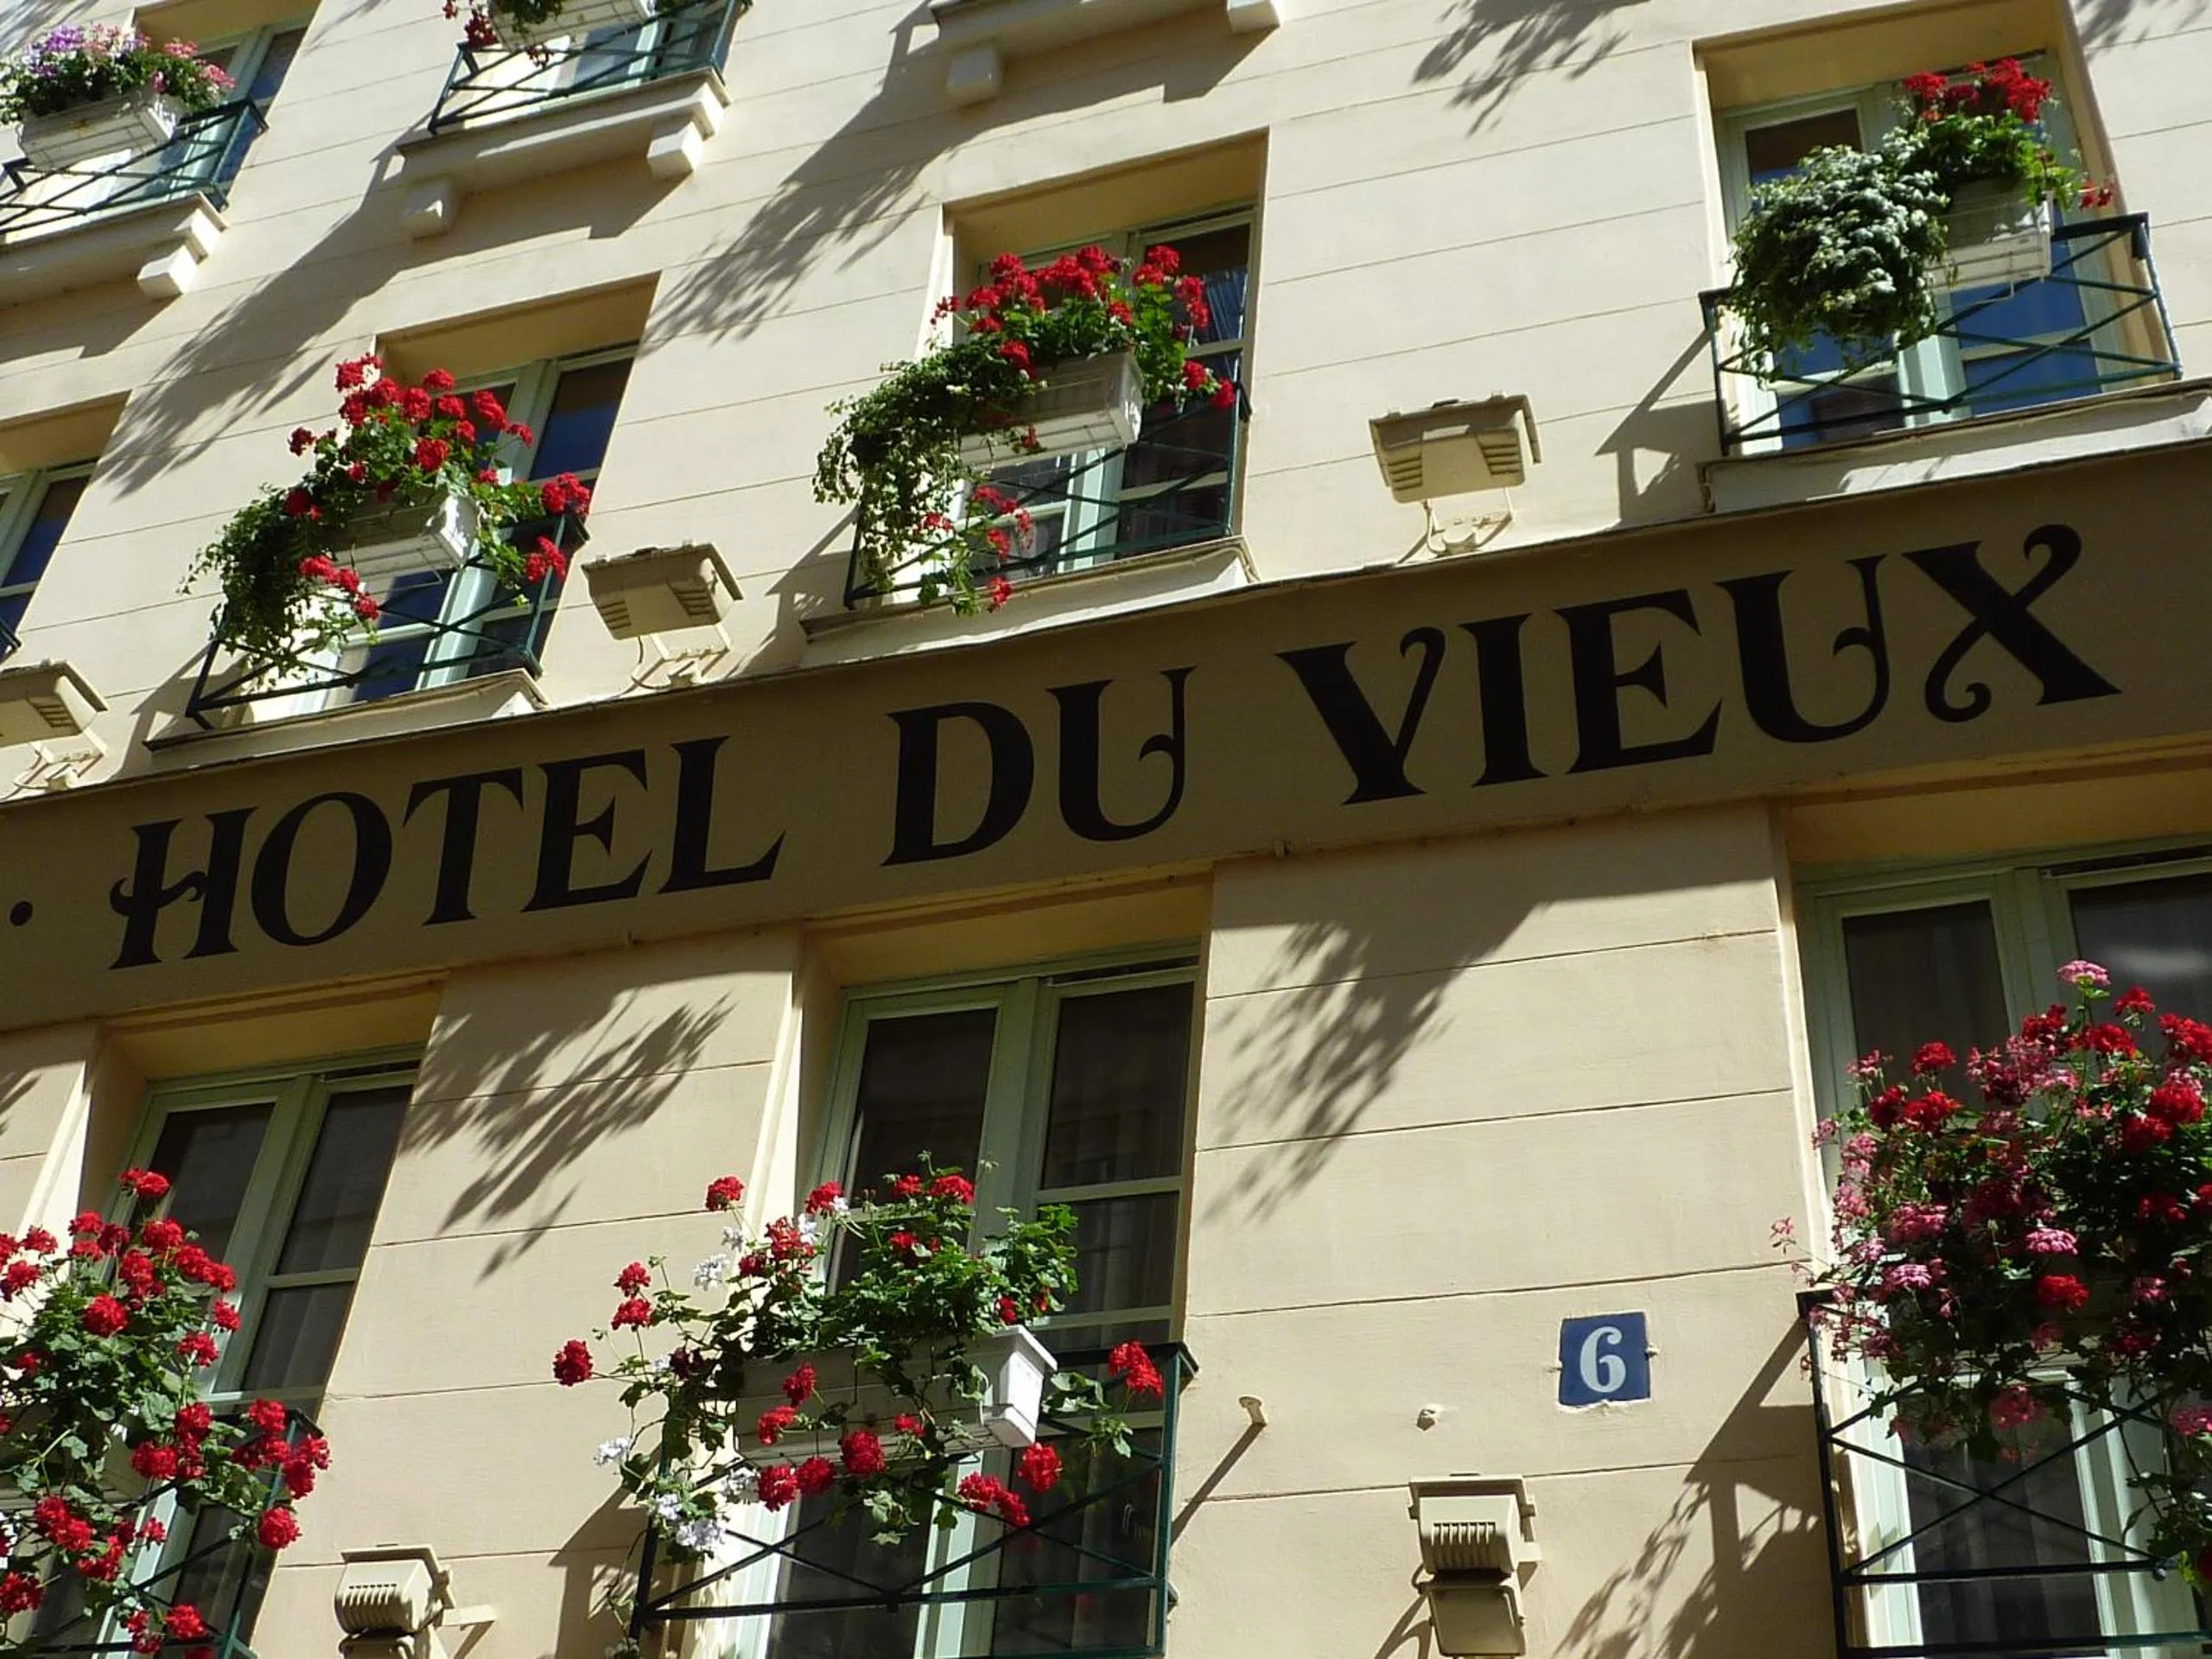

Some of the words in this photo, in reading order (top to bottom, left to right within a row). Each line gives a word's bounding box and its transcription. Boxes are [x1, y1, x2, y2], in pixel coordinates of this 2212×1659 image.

[108, 734, 787, 971] HOTEL
[880, 664, 1198, 866] DU
[1274, 524, 2122, 805] VIEUX
[1580, 1325, 1626, 1393] 6
